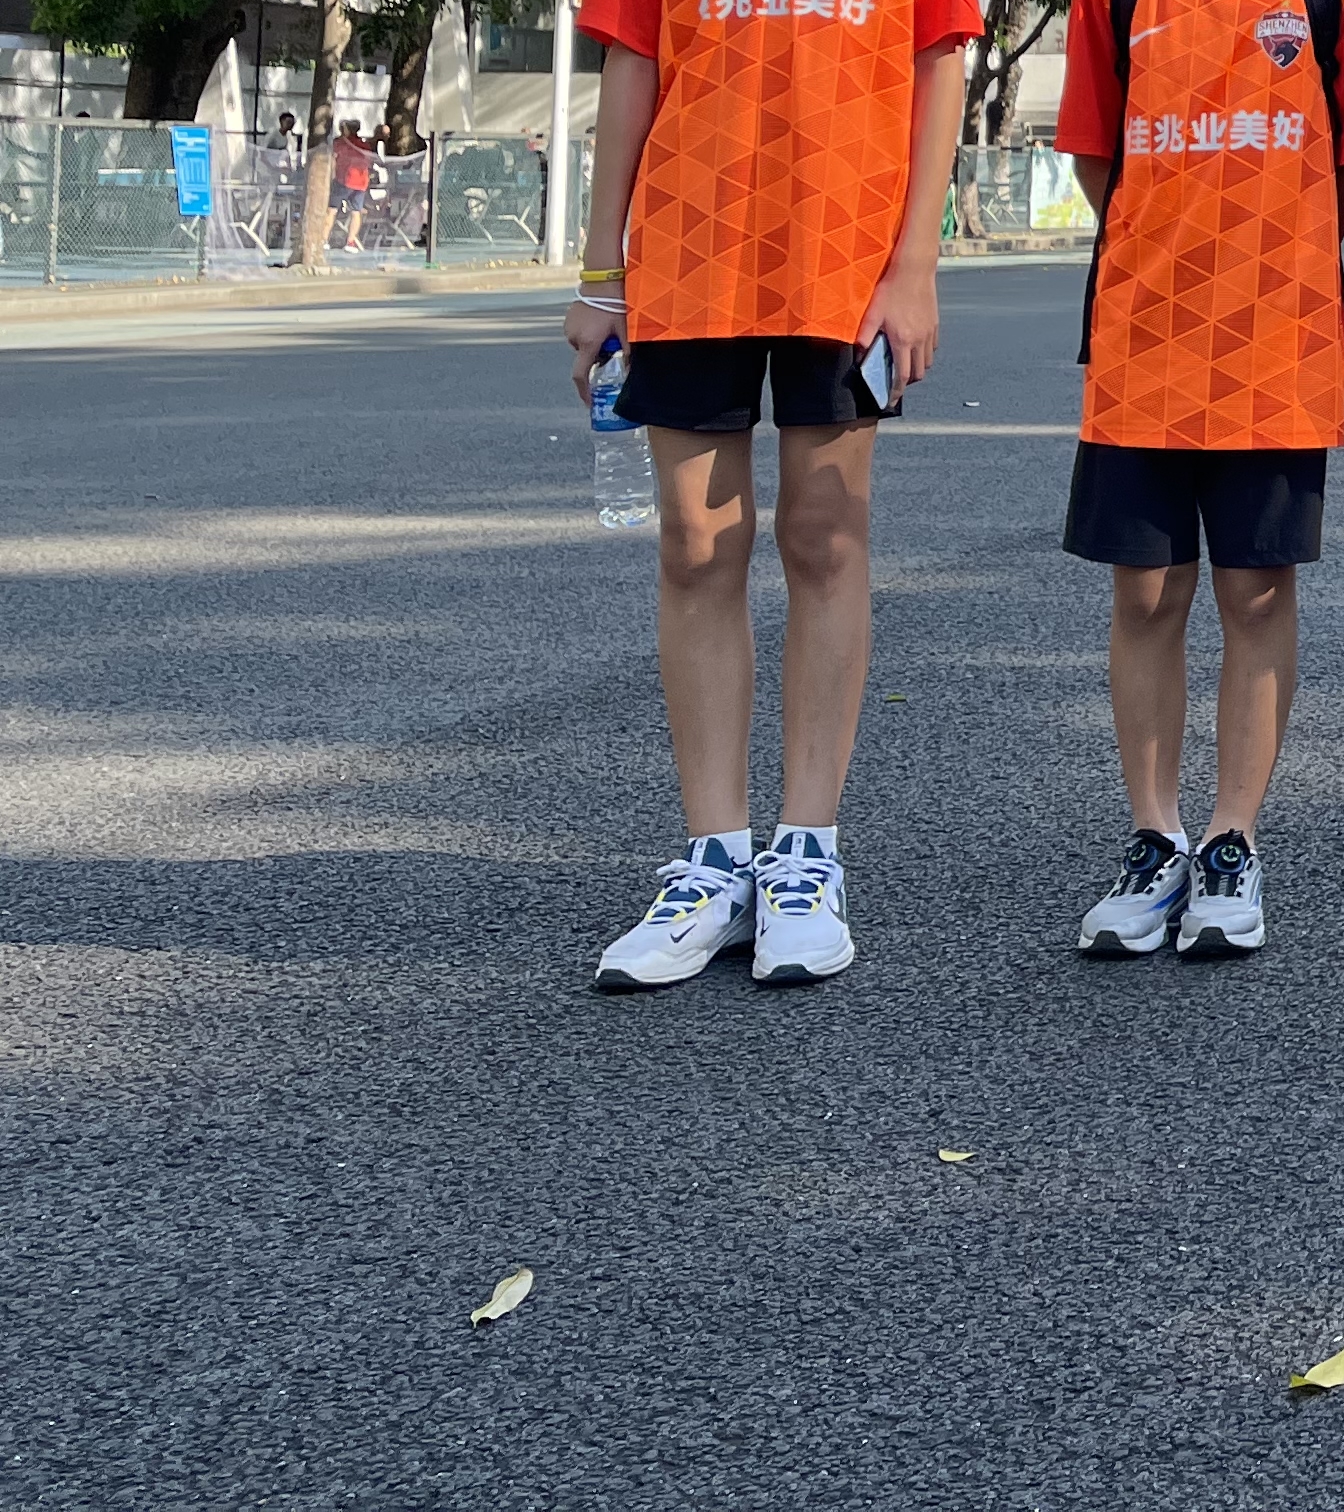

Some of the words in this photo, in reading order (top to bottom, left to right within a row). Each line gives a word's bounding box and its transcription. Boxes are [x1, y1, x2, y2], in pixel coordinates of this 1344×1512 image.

[1258, 19, 1308, 34] SHENZHEN
[1125, 109, 1305, 155] 佳兆业美好
